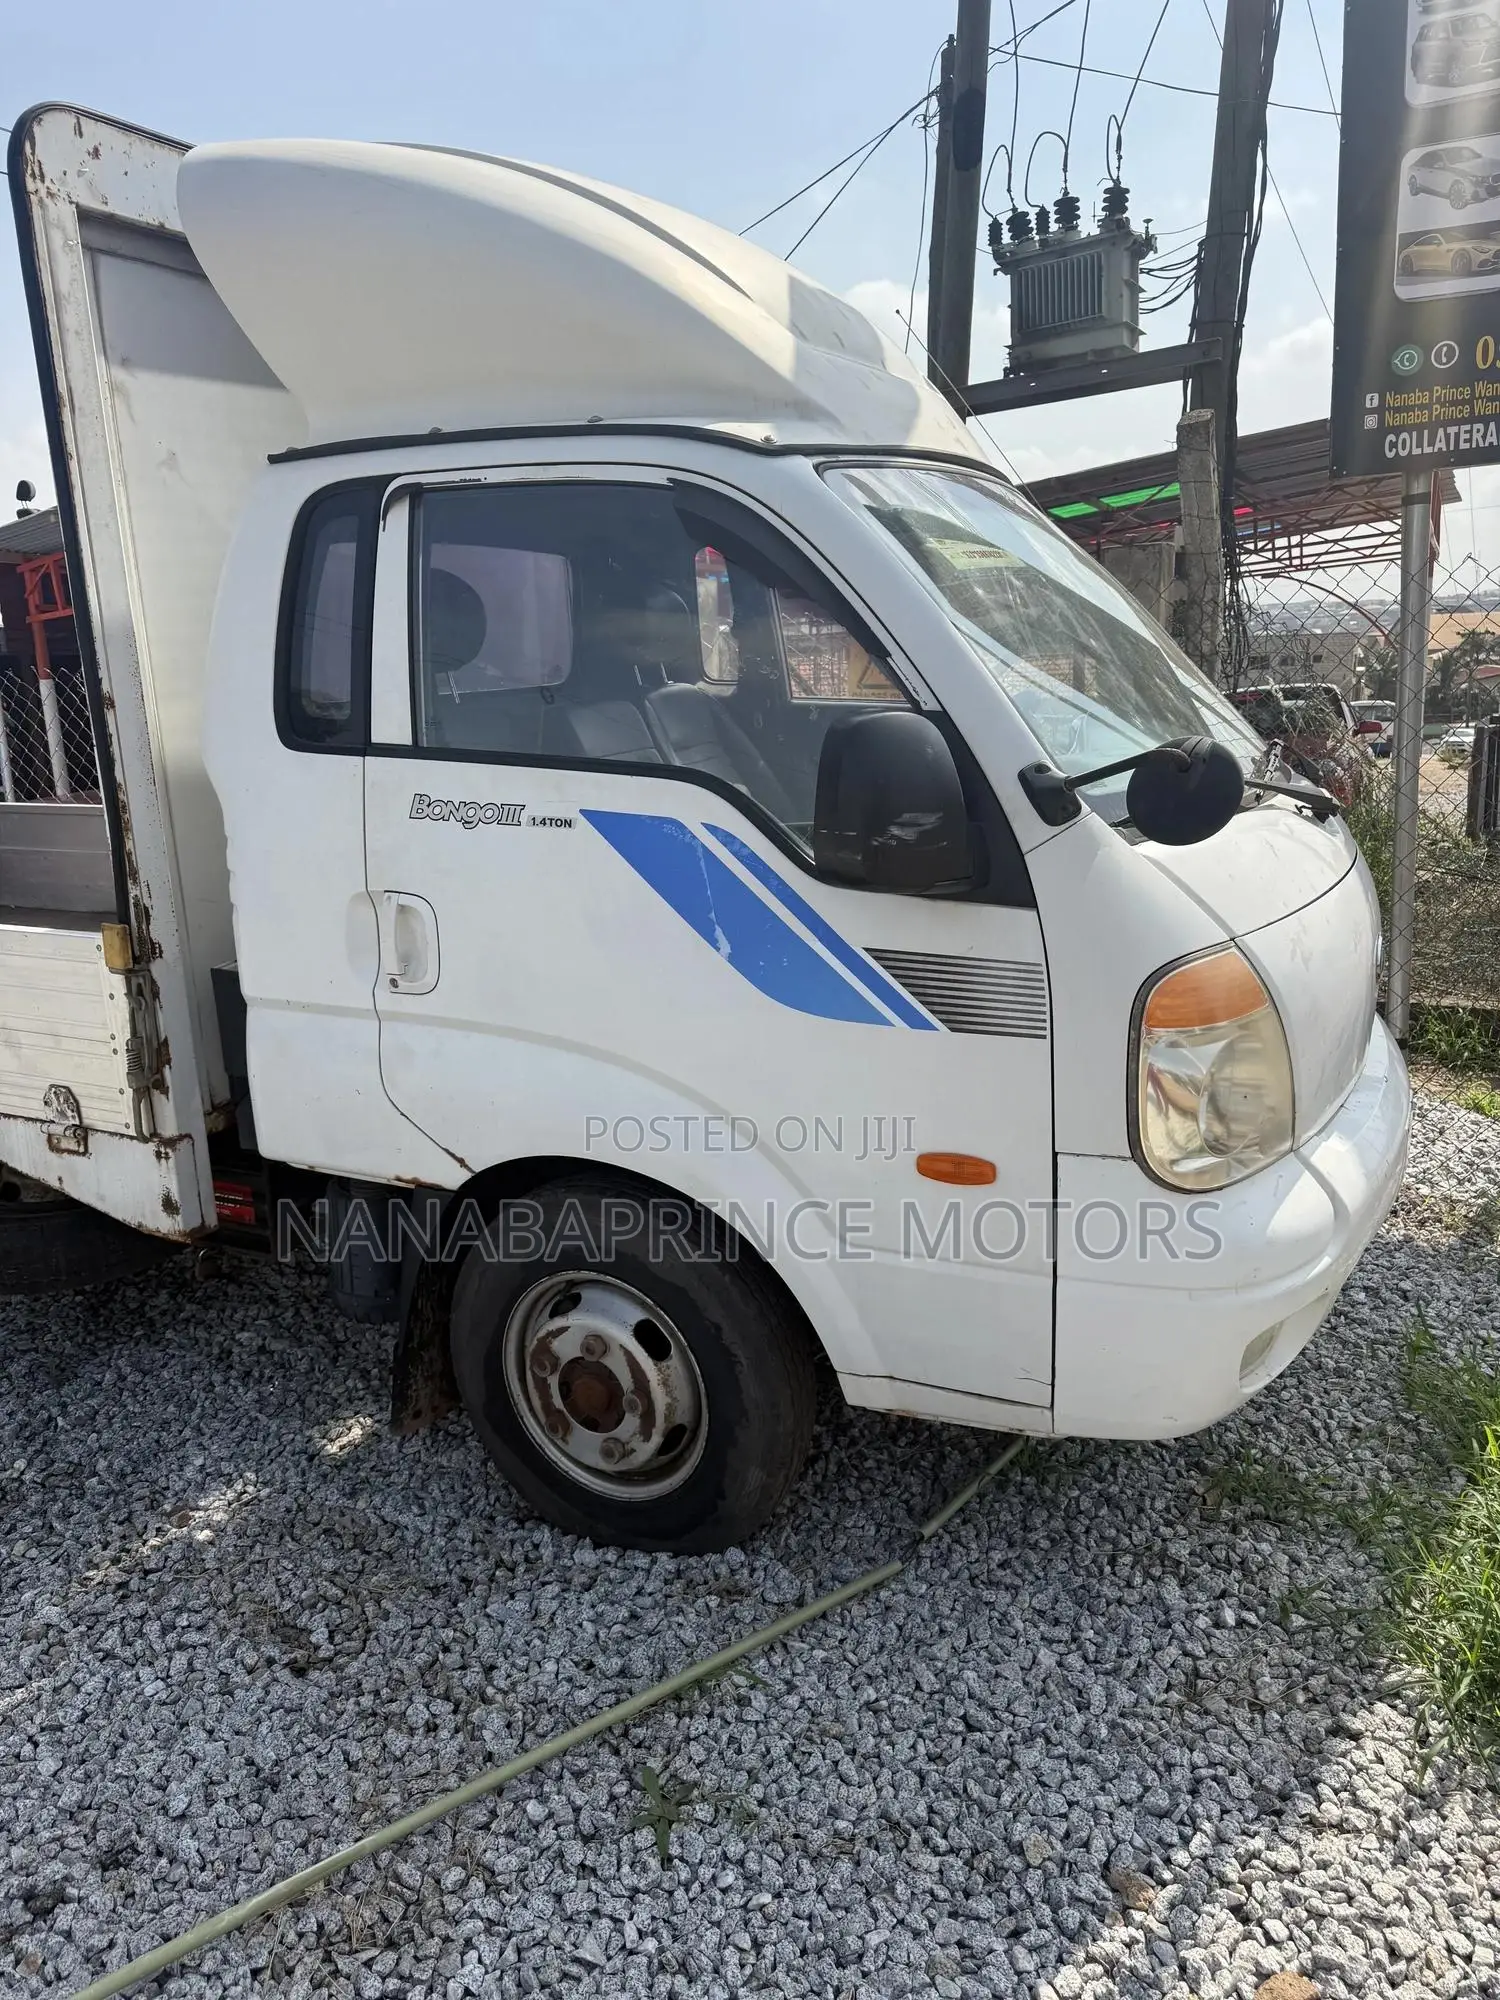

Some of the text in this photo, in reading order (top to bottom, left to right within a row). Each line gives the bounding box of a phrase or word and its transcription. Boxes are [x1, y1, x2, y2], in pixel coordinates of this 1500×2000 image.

[1475, 335, 1500, 370] 0
[1385, 388, 1430, 408] Nanaba
[1433, 384, 1471, 403] Prince
[1385, 407, 1429, 427] Nanaba
[1432, 403, 1470, 421] Prince
[1384, 421, 1500, 459] COLLATERA
